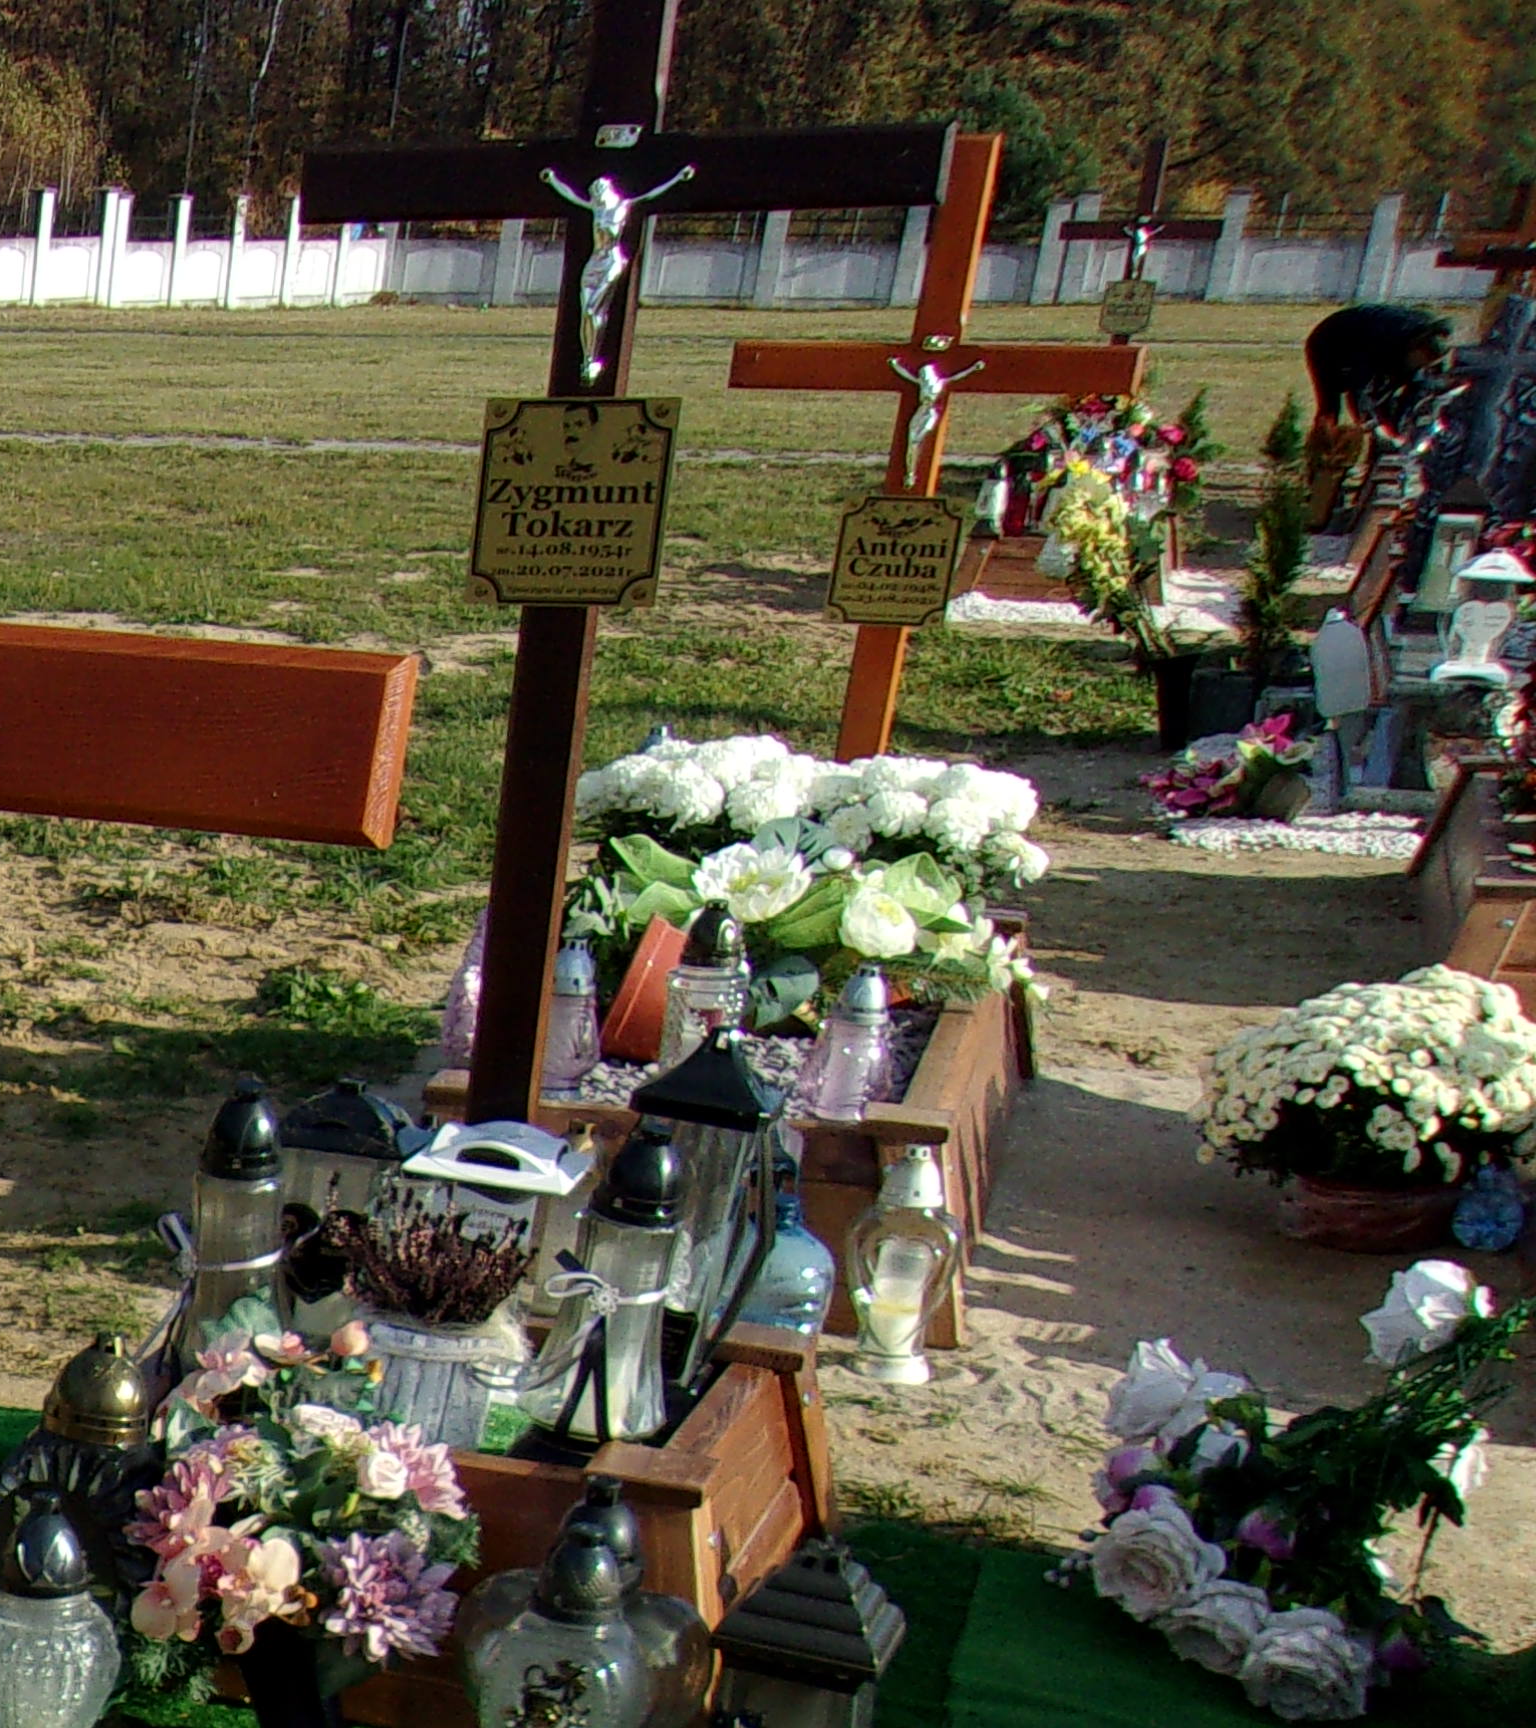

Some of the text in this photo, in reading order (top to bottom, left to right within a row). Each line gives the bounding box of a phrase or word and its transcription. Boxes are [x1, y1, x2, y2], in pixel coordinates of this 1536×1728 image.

[488, 479, 657, 510] Zygmunt
[501, 511, 633, 538] Tokarz
[847, 537, 947, 558] Antoni
[849, 557, 936, 579] Czuba
